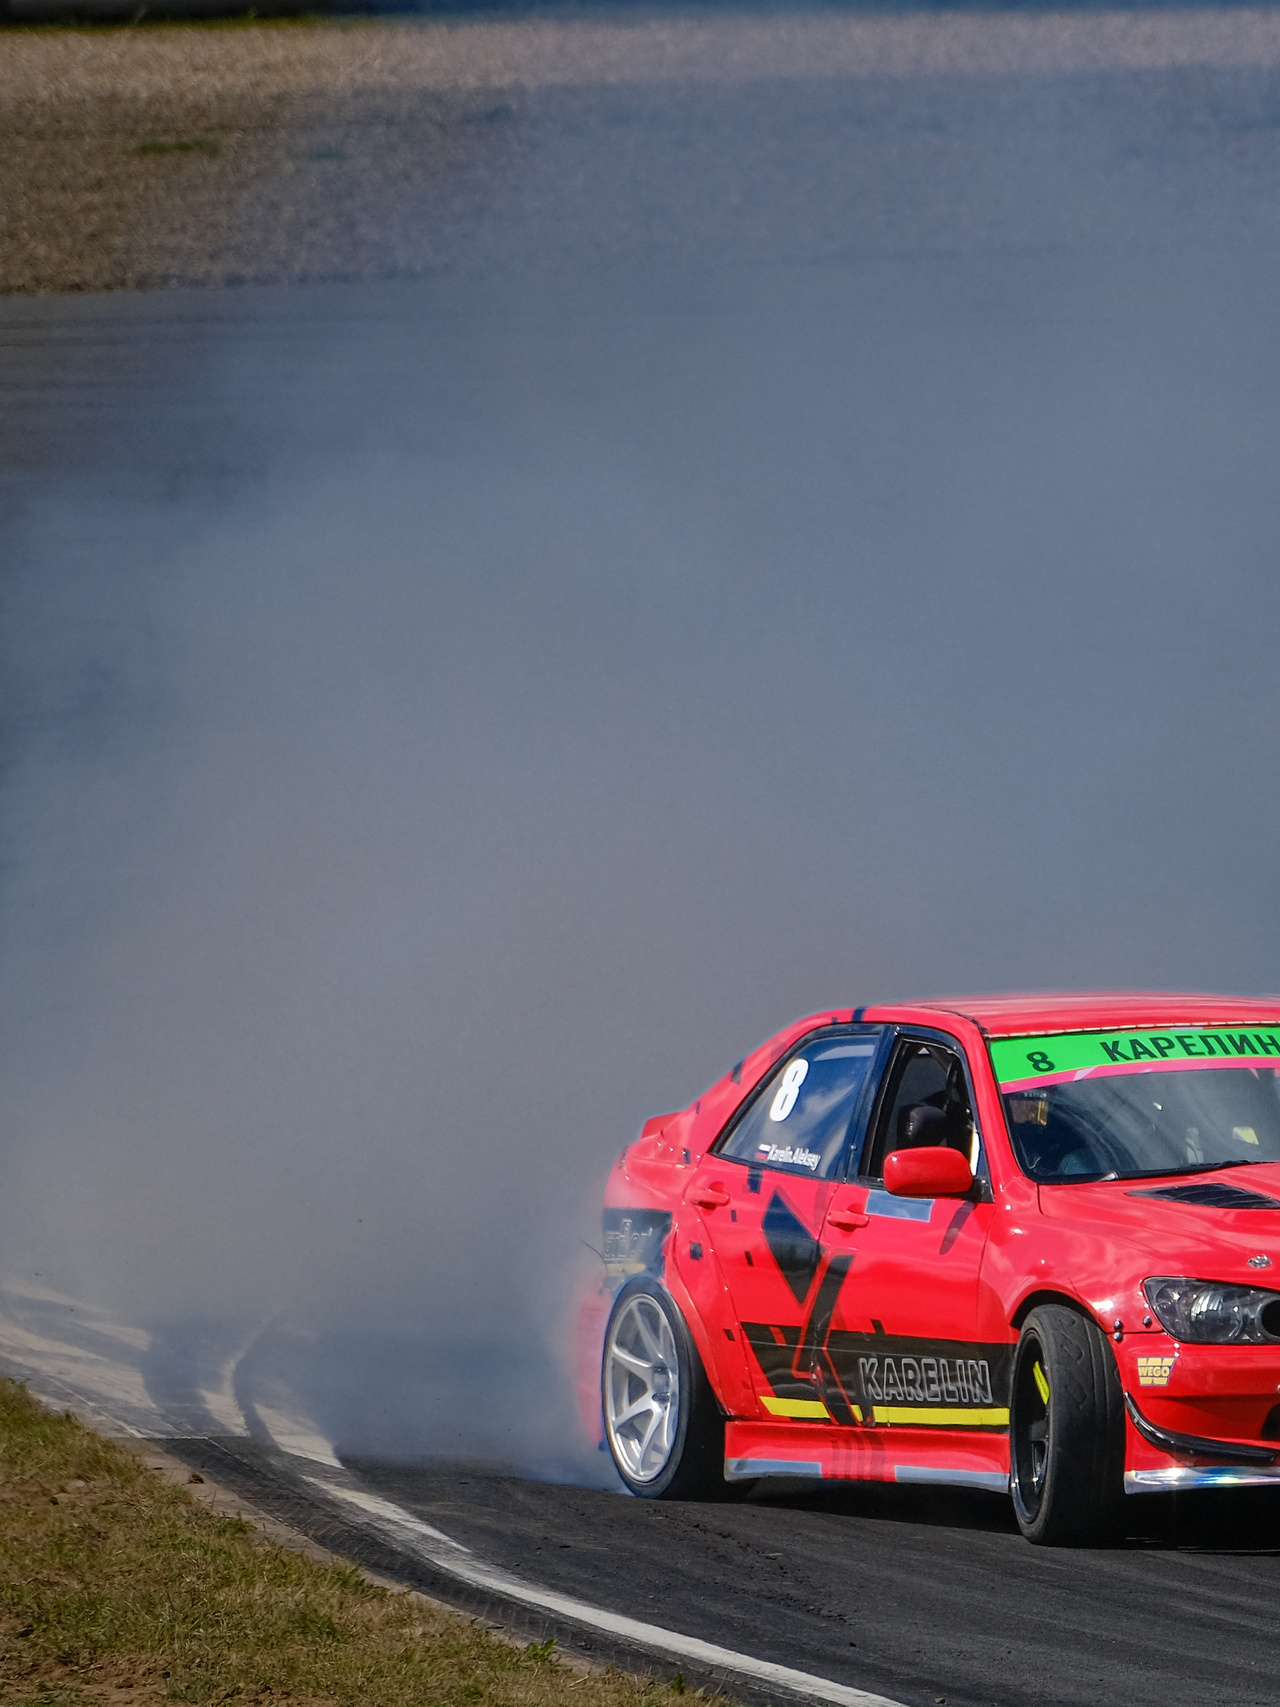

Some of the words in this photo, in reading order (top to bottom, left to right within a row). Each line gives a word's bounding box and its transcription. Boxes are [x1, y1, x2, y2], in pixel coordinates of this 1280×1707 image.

[1026, 1051, 1055, 1072] 8
[769, 1058, 809, 1121] 8
[859, 1357, 993, 1404] KARELIN
[1138, 1366, 1170, 1377] WEGO
